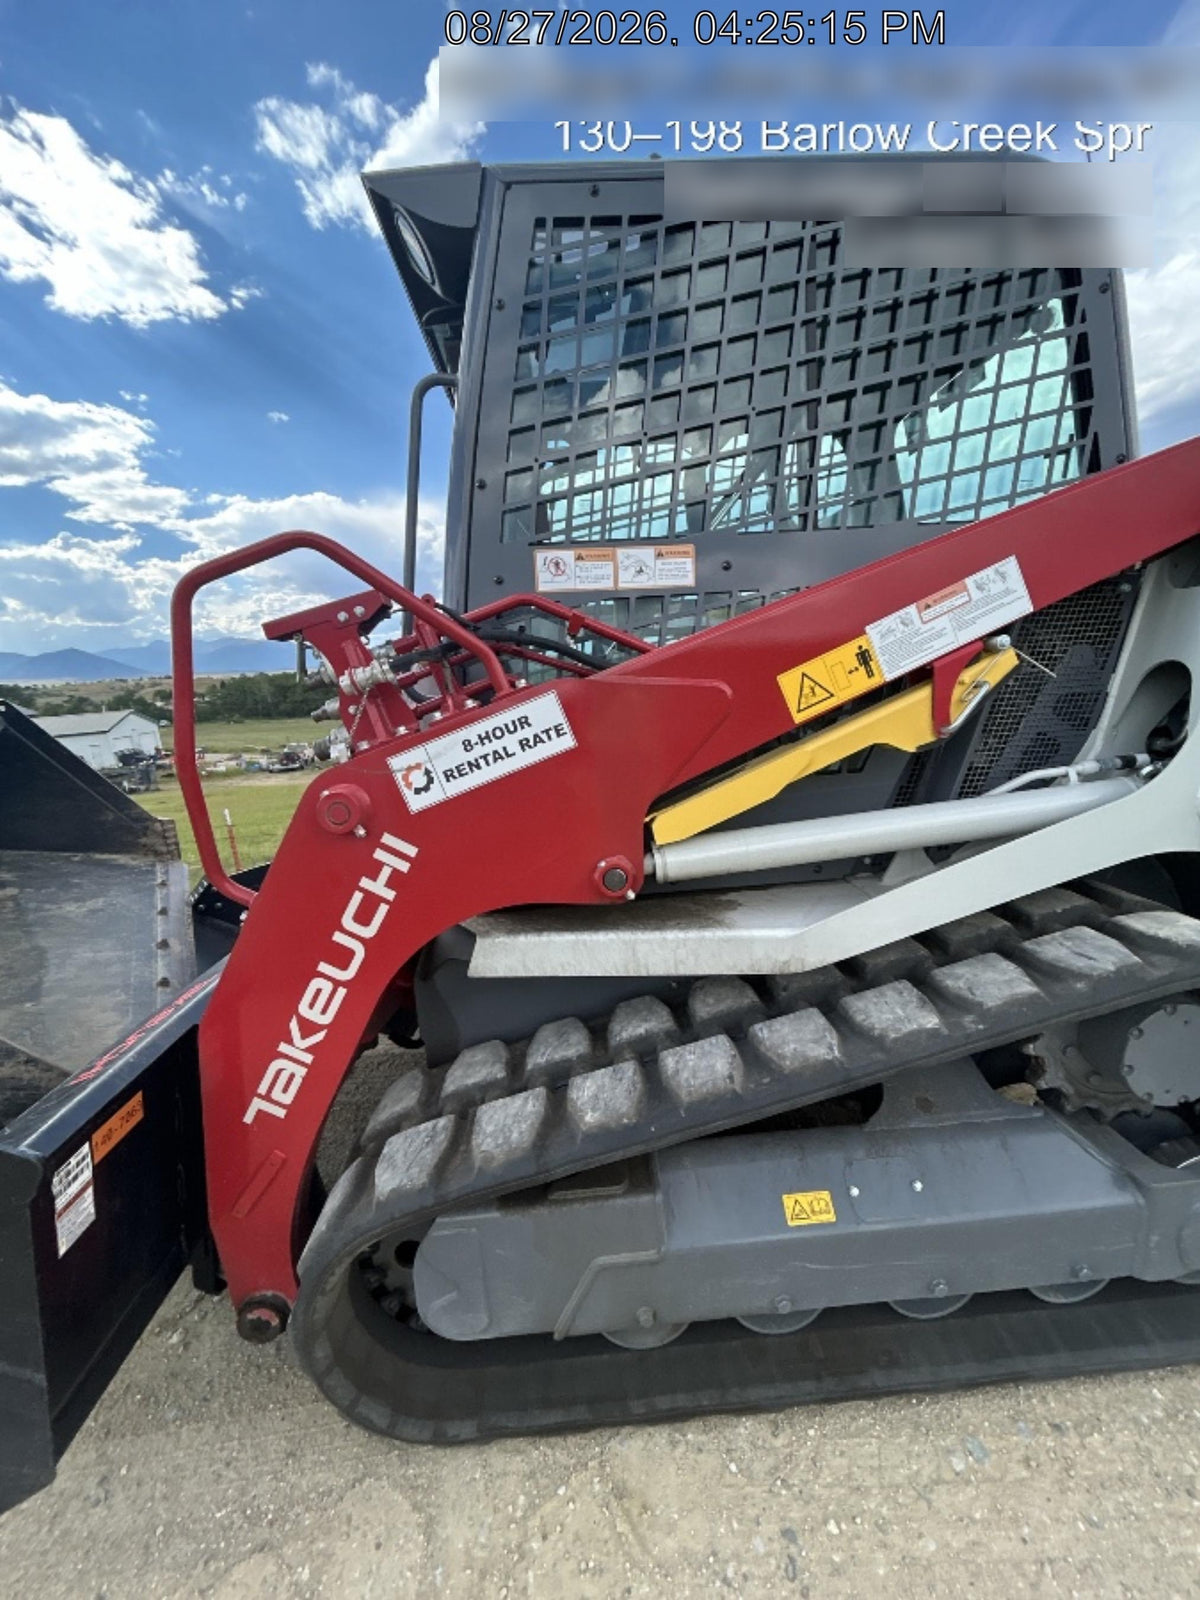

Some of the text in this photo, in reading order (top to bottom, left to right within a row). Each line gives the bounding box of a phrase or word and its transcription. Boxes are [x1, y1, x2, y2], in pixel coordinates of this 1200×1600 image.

[442, 722, 568, 782] RENTAL RATE
[461, 715, 532, 753] 8-HOUR
